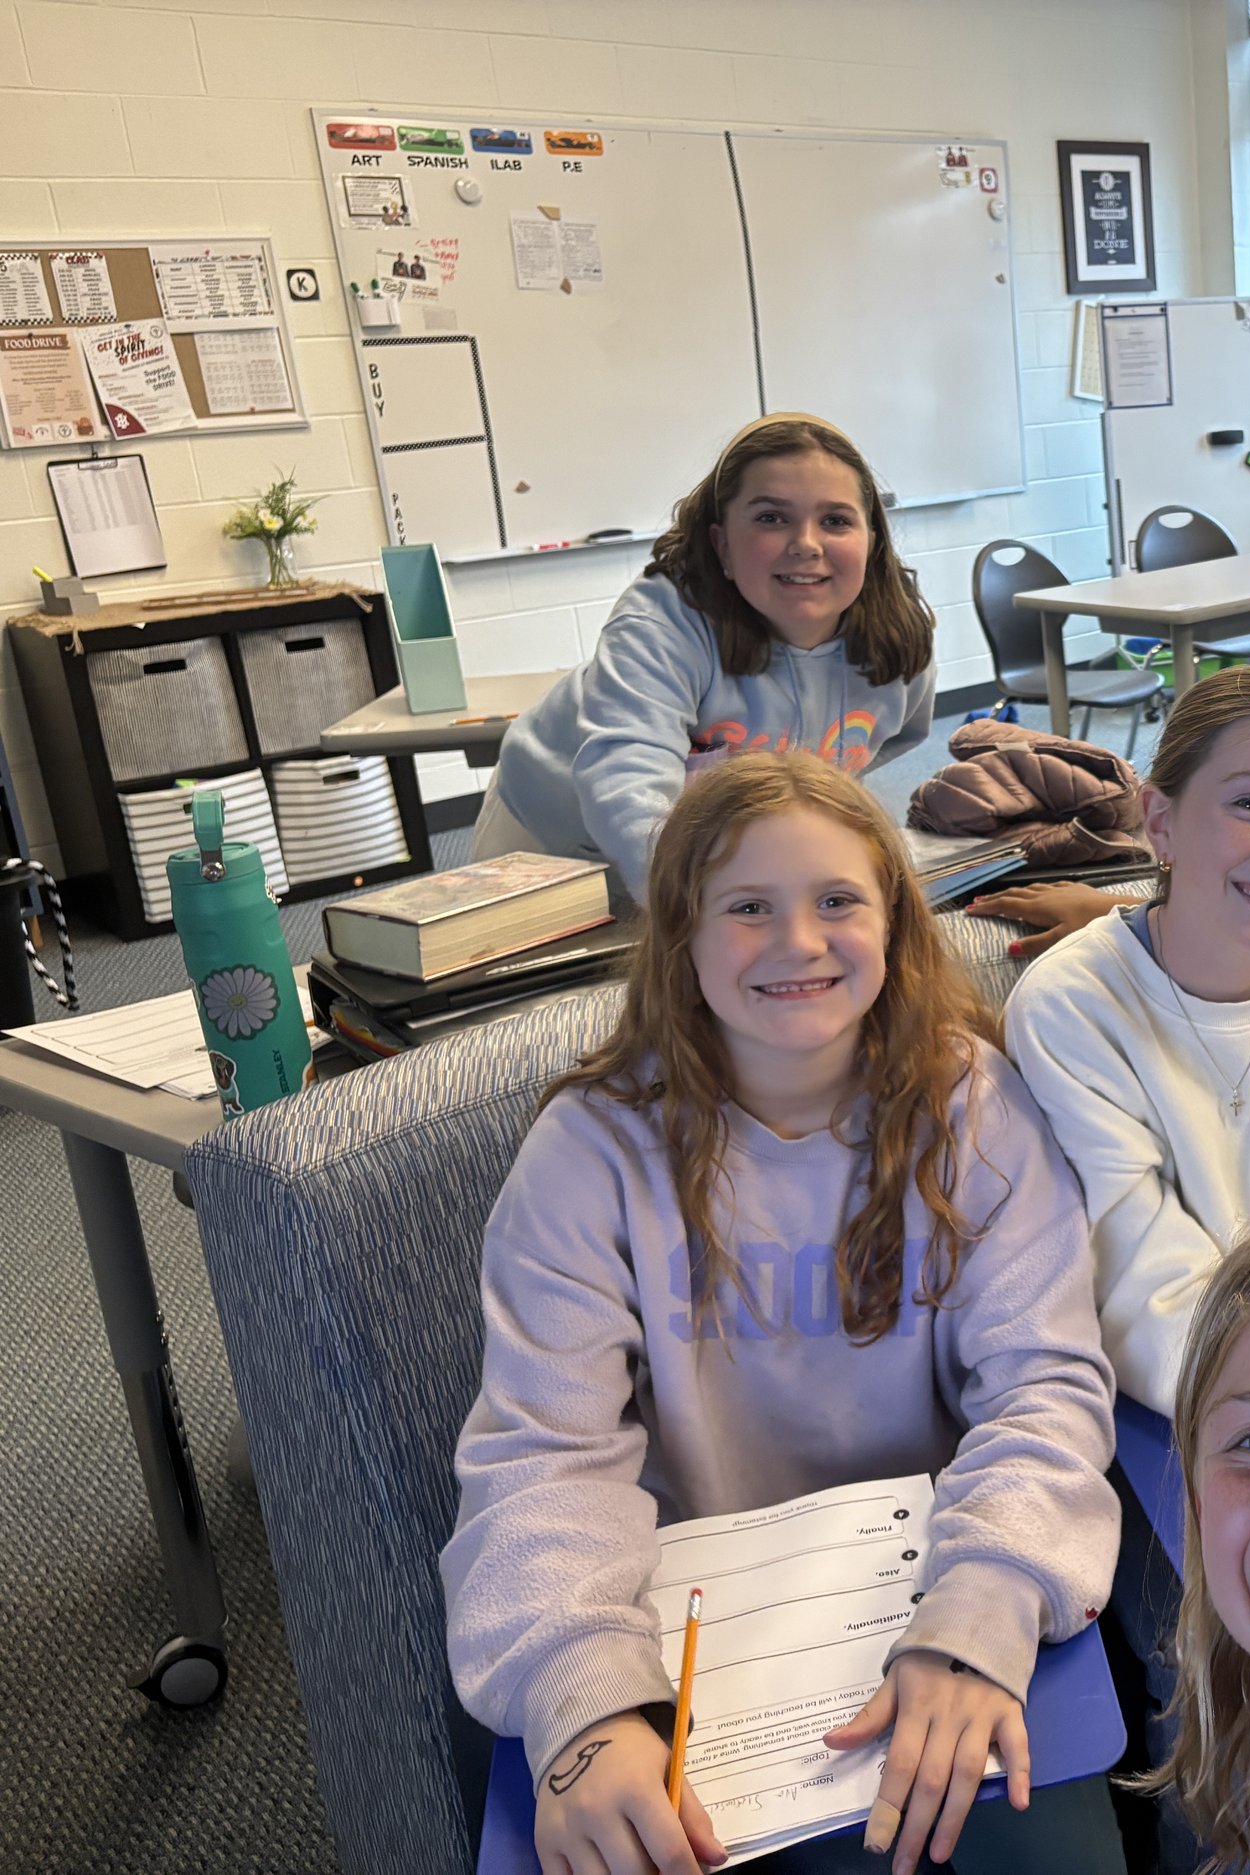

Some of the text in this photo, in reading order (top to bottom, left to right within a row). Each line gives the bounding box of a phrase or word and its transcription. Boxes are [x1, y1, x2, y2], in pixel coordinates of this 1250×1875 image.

[351, 154, 382, 166] ART
[407, 155, 469, 169] SPANISH
[490, 159, 522, 171] ILAB
[297, 277, 308, 291] K
[5, 337, 62, 349] FOOD DRIVE
[97, 342, 112, 352] GET
[114, 339, 145, 357] SPIRIT
[369, 364, 384, 417] BUY
[272, 1050, 290, 1094] STANLEY
[838, 1689, 865, 1700] Today
[805, 1701, 817, 1709] be
[818, 1697, 833, 1707] will
[745, 1712, 763, 1723] you
[764, 1704, 805, 1719] teaching
[832, 1712, 847, 1722] you
[717, 1716, 744, 1730] about
[810, 1716, 832, 1727] know
[766, 1728, 775, 1737] be
[776, 1724, 792, 1735] and
[787, 1729, 812, 1742] about
[812, 1725, 832, 1735] class
[730, 1738, 739, 1746] to
[739, 1731, 765, 1745] ready
[720, 1747, 741, 1758] Write
[800, 1752, 830, 1765] Topic:
[691, 1754, 712, 1765] facts
[800, 1776, 834, 1789] Name:
